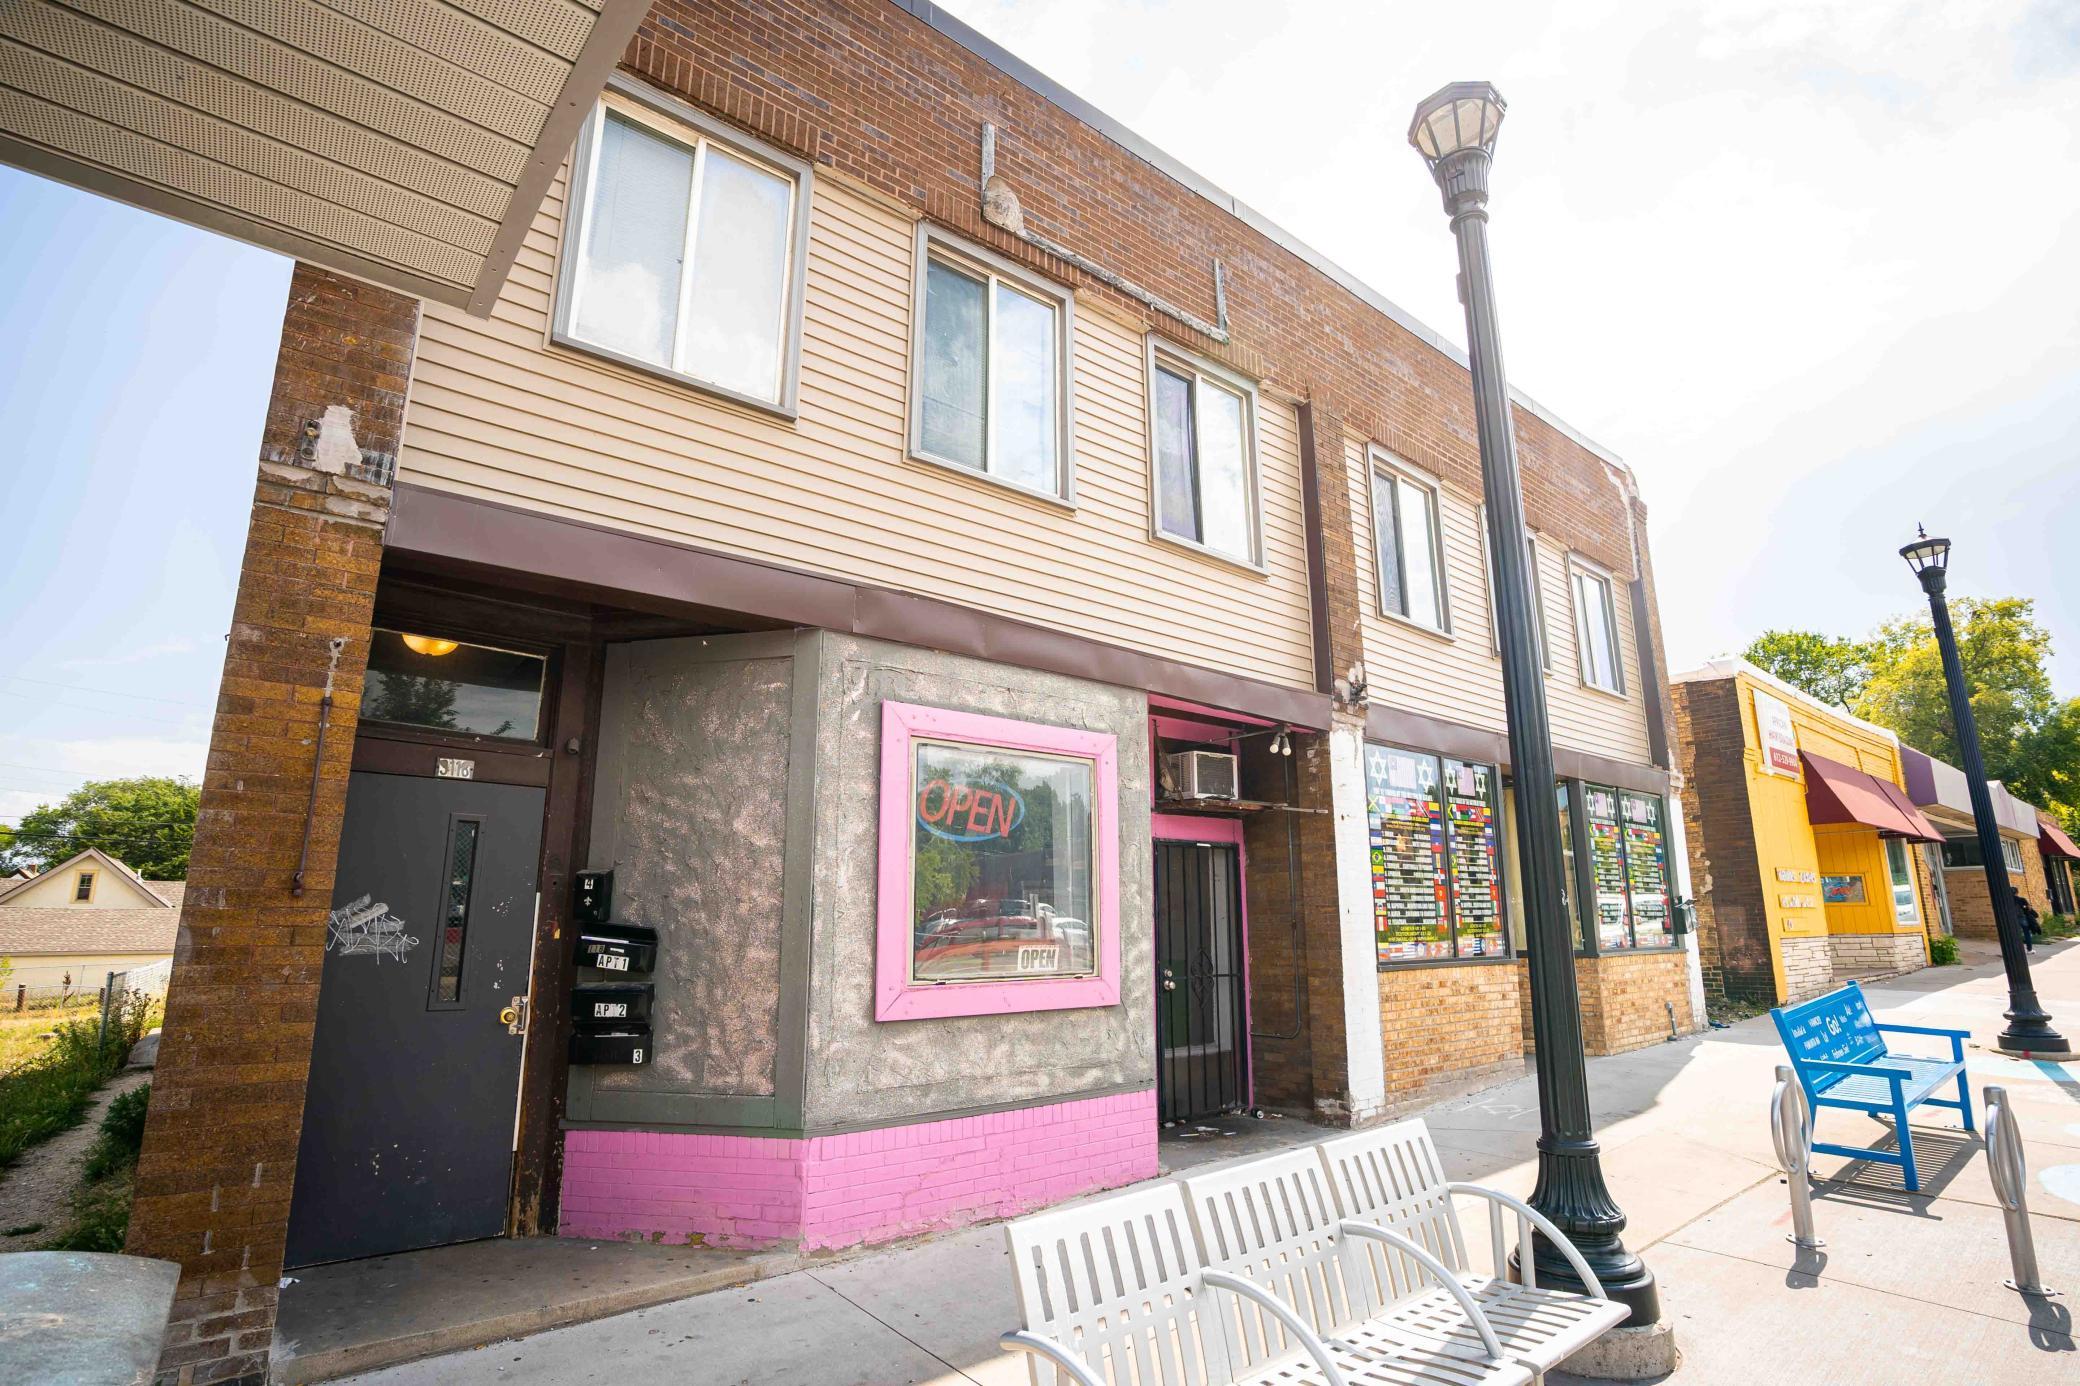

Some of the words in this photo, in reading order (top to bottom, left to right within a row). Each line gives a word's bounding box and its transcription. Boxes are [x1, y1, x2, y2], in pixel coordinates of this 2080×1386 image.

[919, 778, 1017, 838] OPEN
[585, 879, 592, 887] 4
[1020, 949, 1057, 969] OPEN
[618, 1004, 626, 1016] 2
[1825, 1014, 1842, 1036] Go!
[634, 1050, 641, 1062] 3
